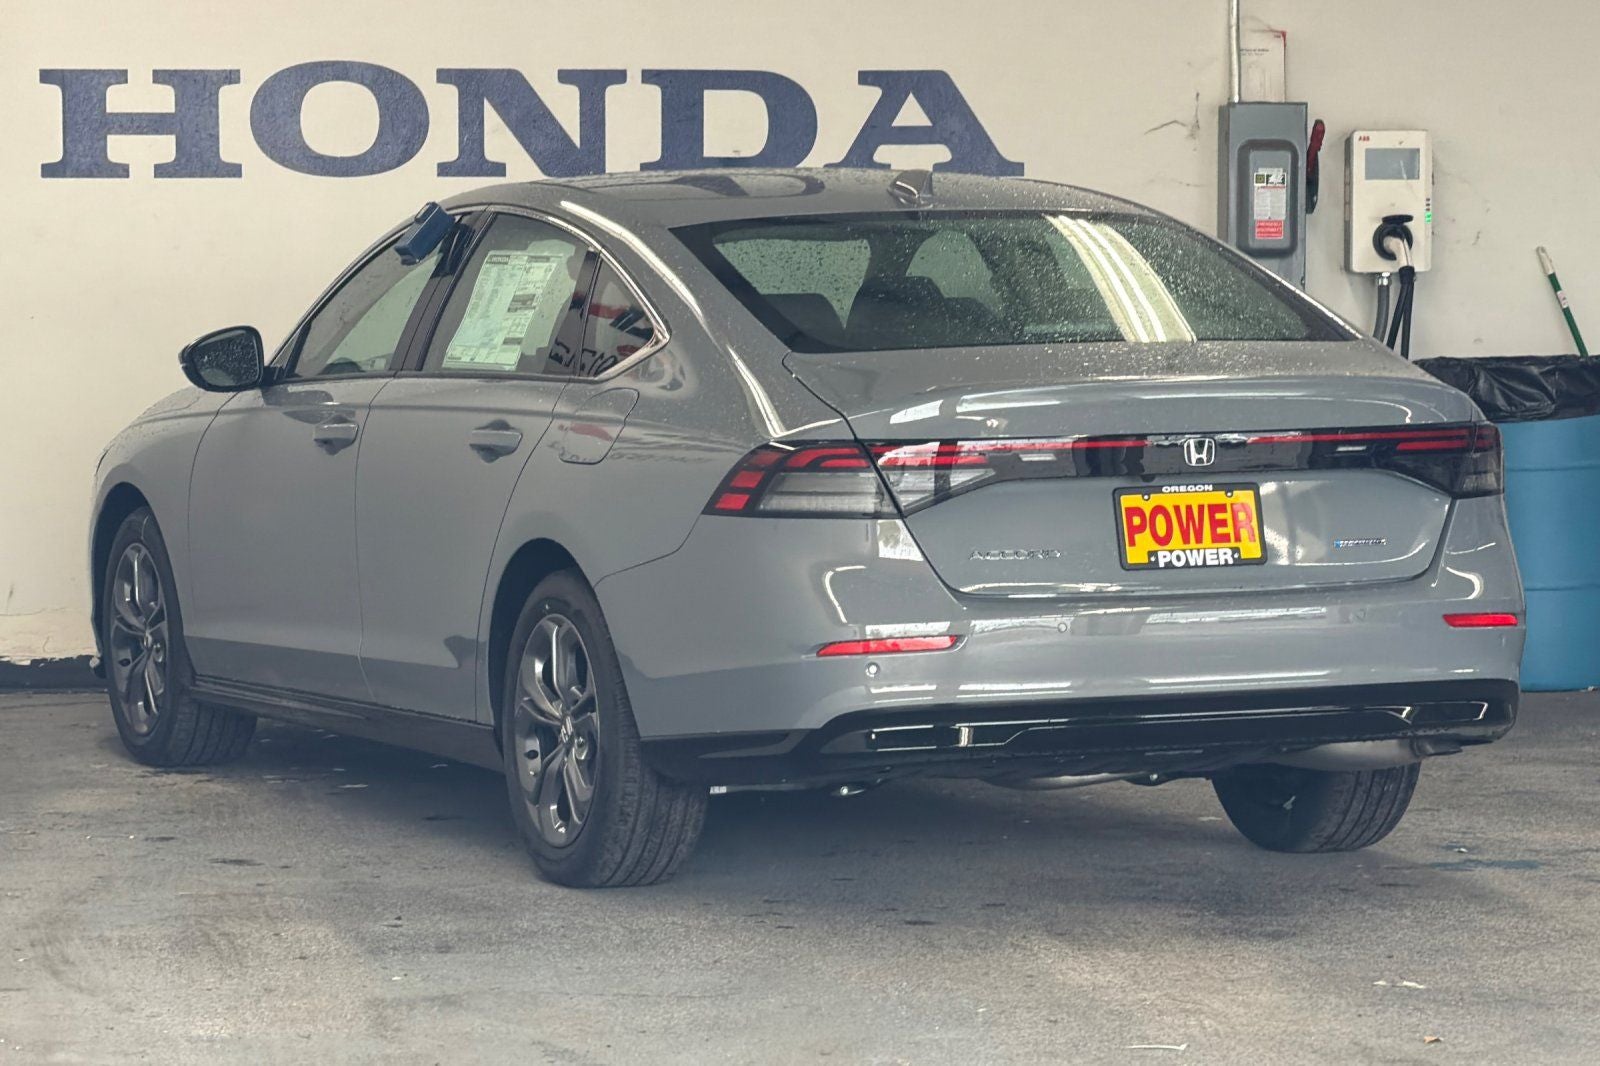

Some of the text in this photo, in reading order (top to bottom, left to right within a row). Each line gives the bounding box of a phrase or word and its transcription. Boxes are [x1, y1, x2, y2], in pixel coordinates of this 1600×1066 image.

[39, 60, 1025, 179] HONDA
[1161, 484, 1214, 493] OREGON
[1124, 502, 1257, 548] POWER
[968, 548, 1062, 561] ACCORD
[1157, 547, 1234, 568] POWER
